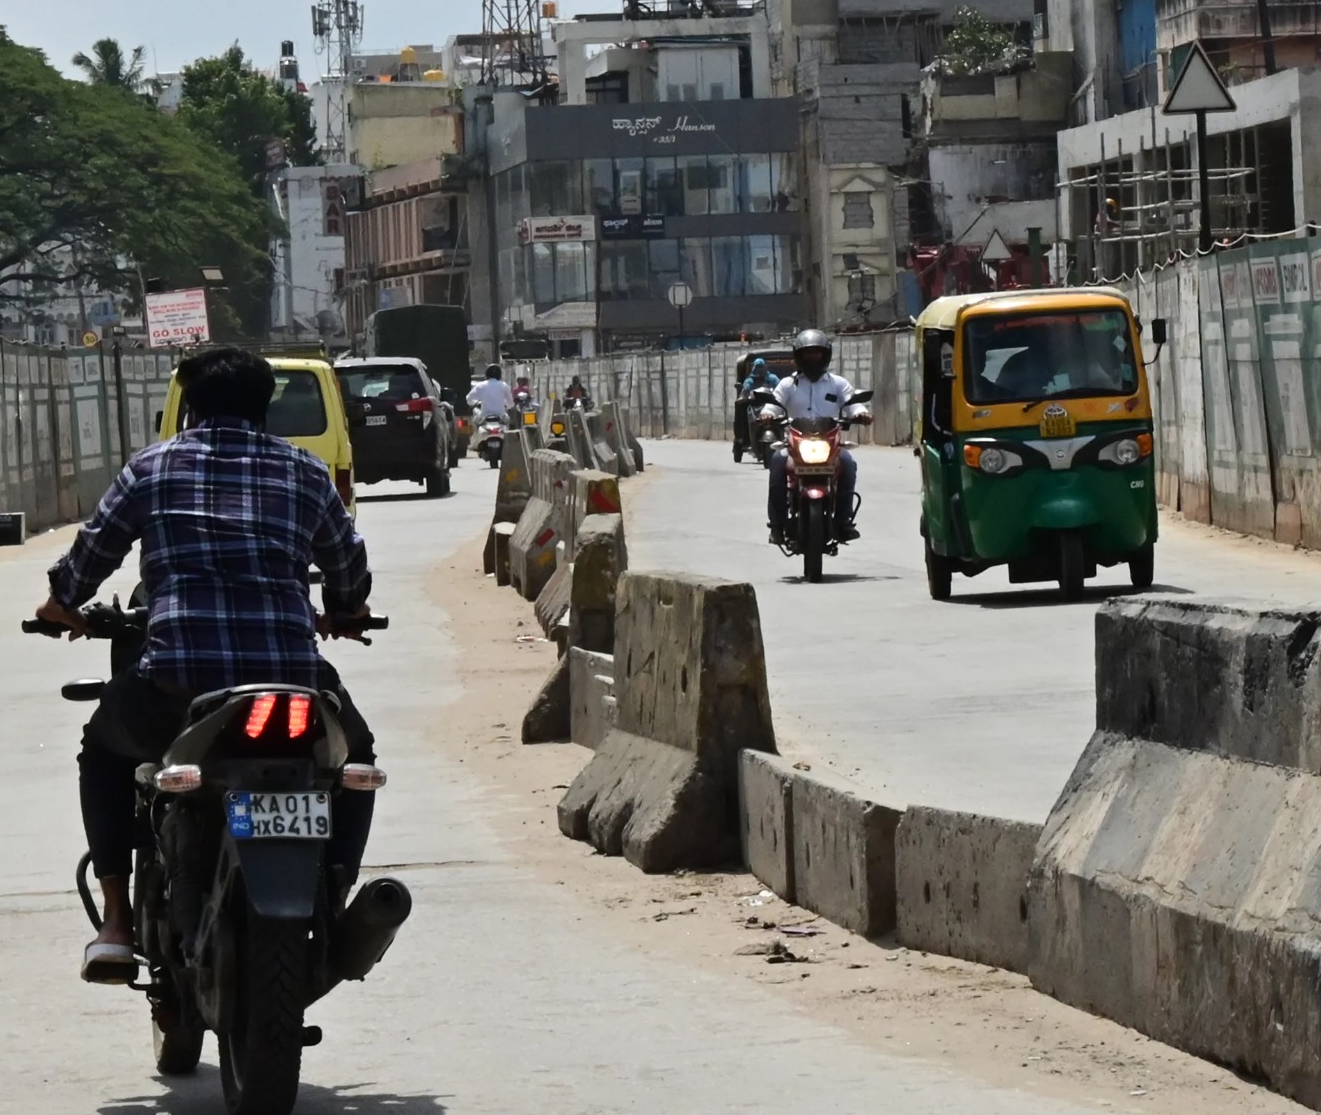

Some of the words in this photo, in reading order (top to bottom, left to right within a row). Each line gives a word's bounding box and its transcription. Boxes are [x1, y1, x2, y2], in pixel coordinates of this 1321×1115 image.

[667, 116, 716, 132] Hanson
[153, 329, 169, 338] GO
[173, 325, 205, 335] SLOW
